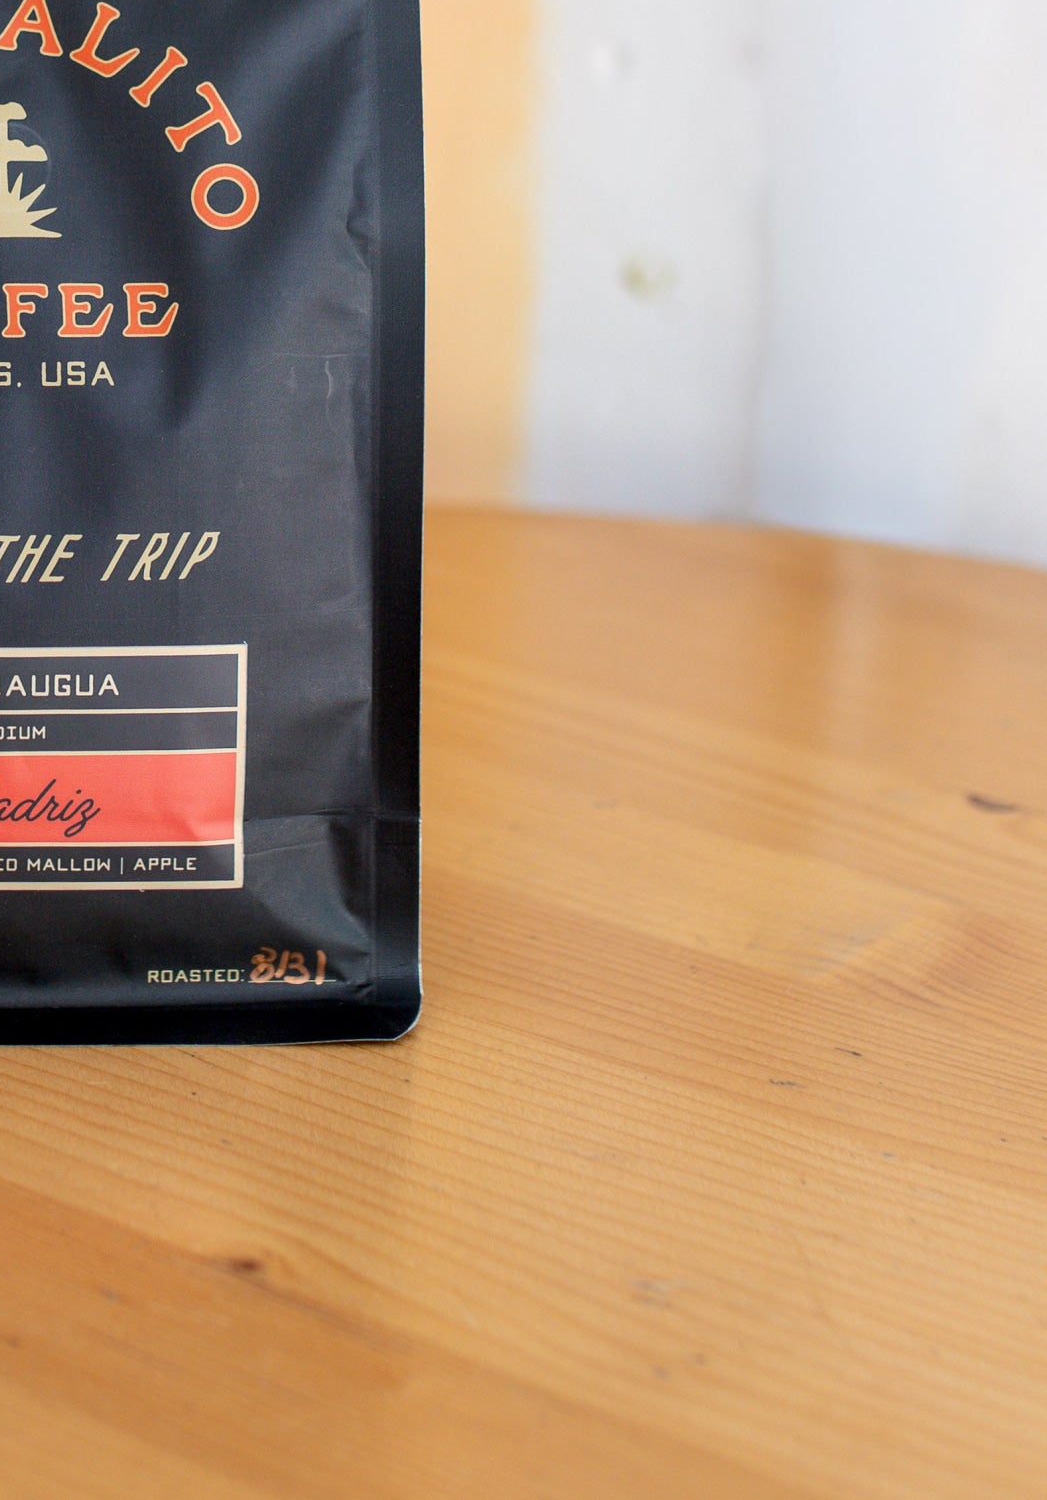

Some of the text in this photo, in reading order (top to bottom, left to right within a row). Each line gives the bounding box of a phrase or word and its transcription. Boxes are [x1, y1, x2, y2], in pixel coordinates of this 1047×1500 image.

[41, 360, 115, 387] USA
[100, 531, 220, 582] TRIP
[26, 857, 111, 872] MALLOW
[133, 856, 197, 872] APPLE
[147, 968, 245, 984] ROASTED:
